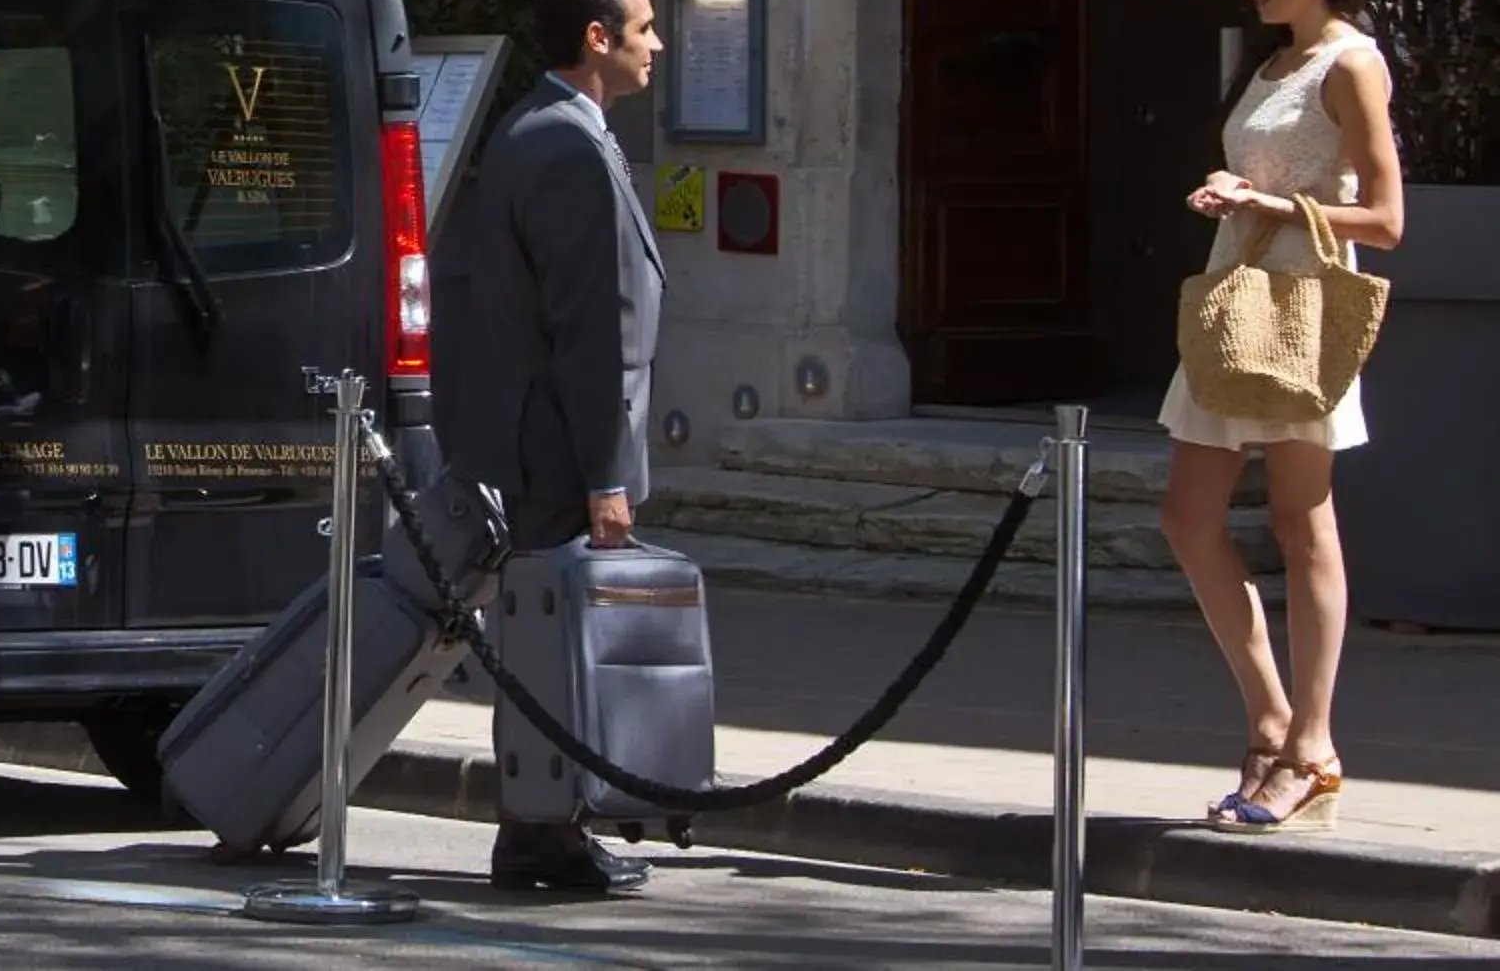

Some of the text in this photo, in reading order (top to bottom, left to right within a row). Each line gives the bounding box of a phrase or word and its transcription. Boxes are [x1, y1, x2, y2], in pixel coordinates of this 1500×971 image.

[207, 168, 296, 188] VALRUGUES
[146, 444, 164, 460] LE
[166, 444, 228, 460] VALLON
[231, 444, 253, 460] DE
[254, 444, 338, 462] VALRUGUES
